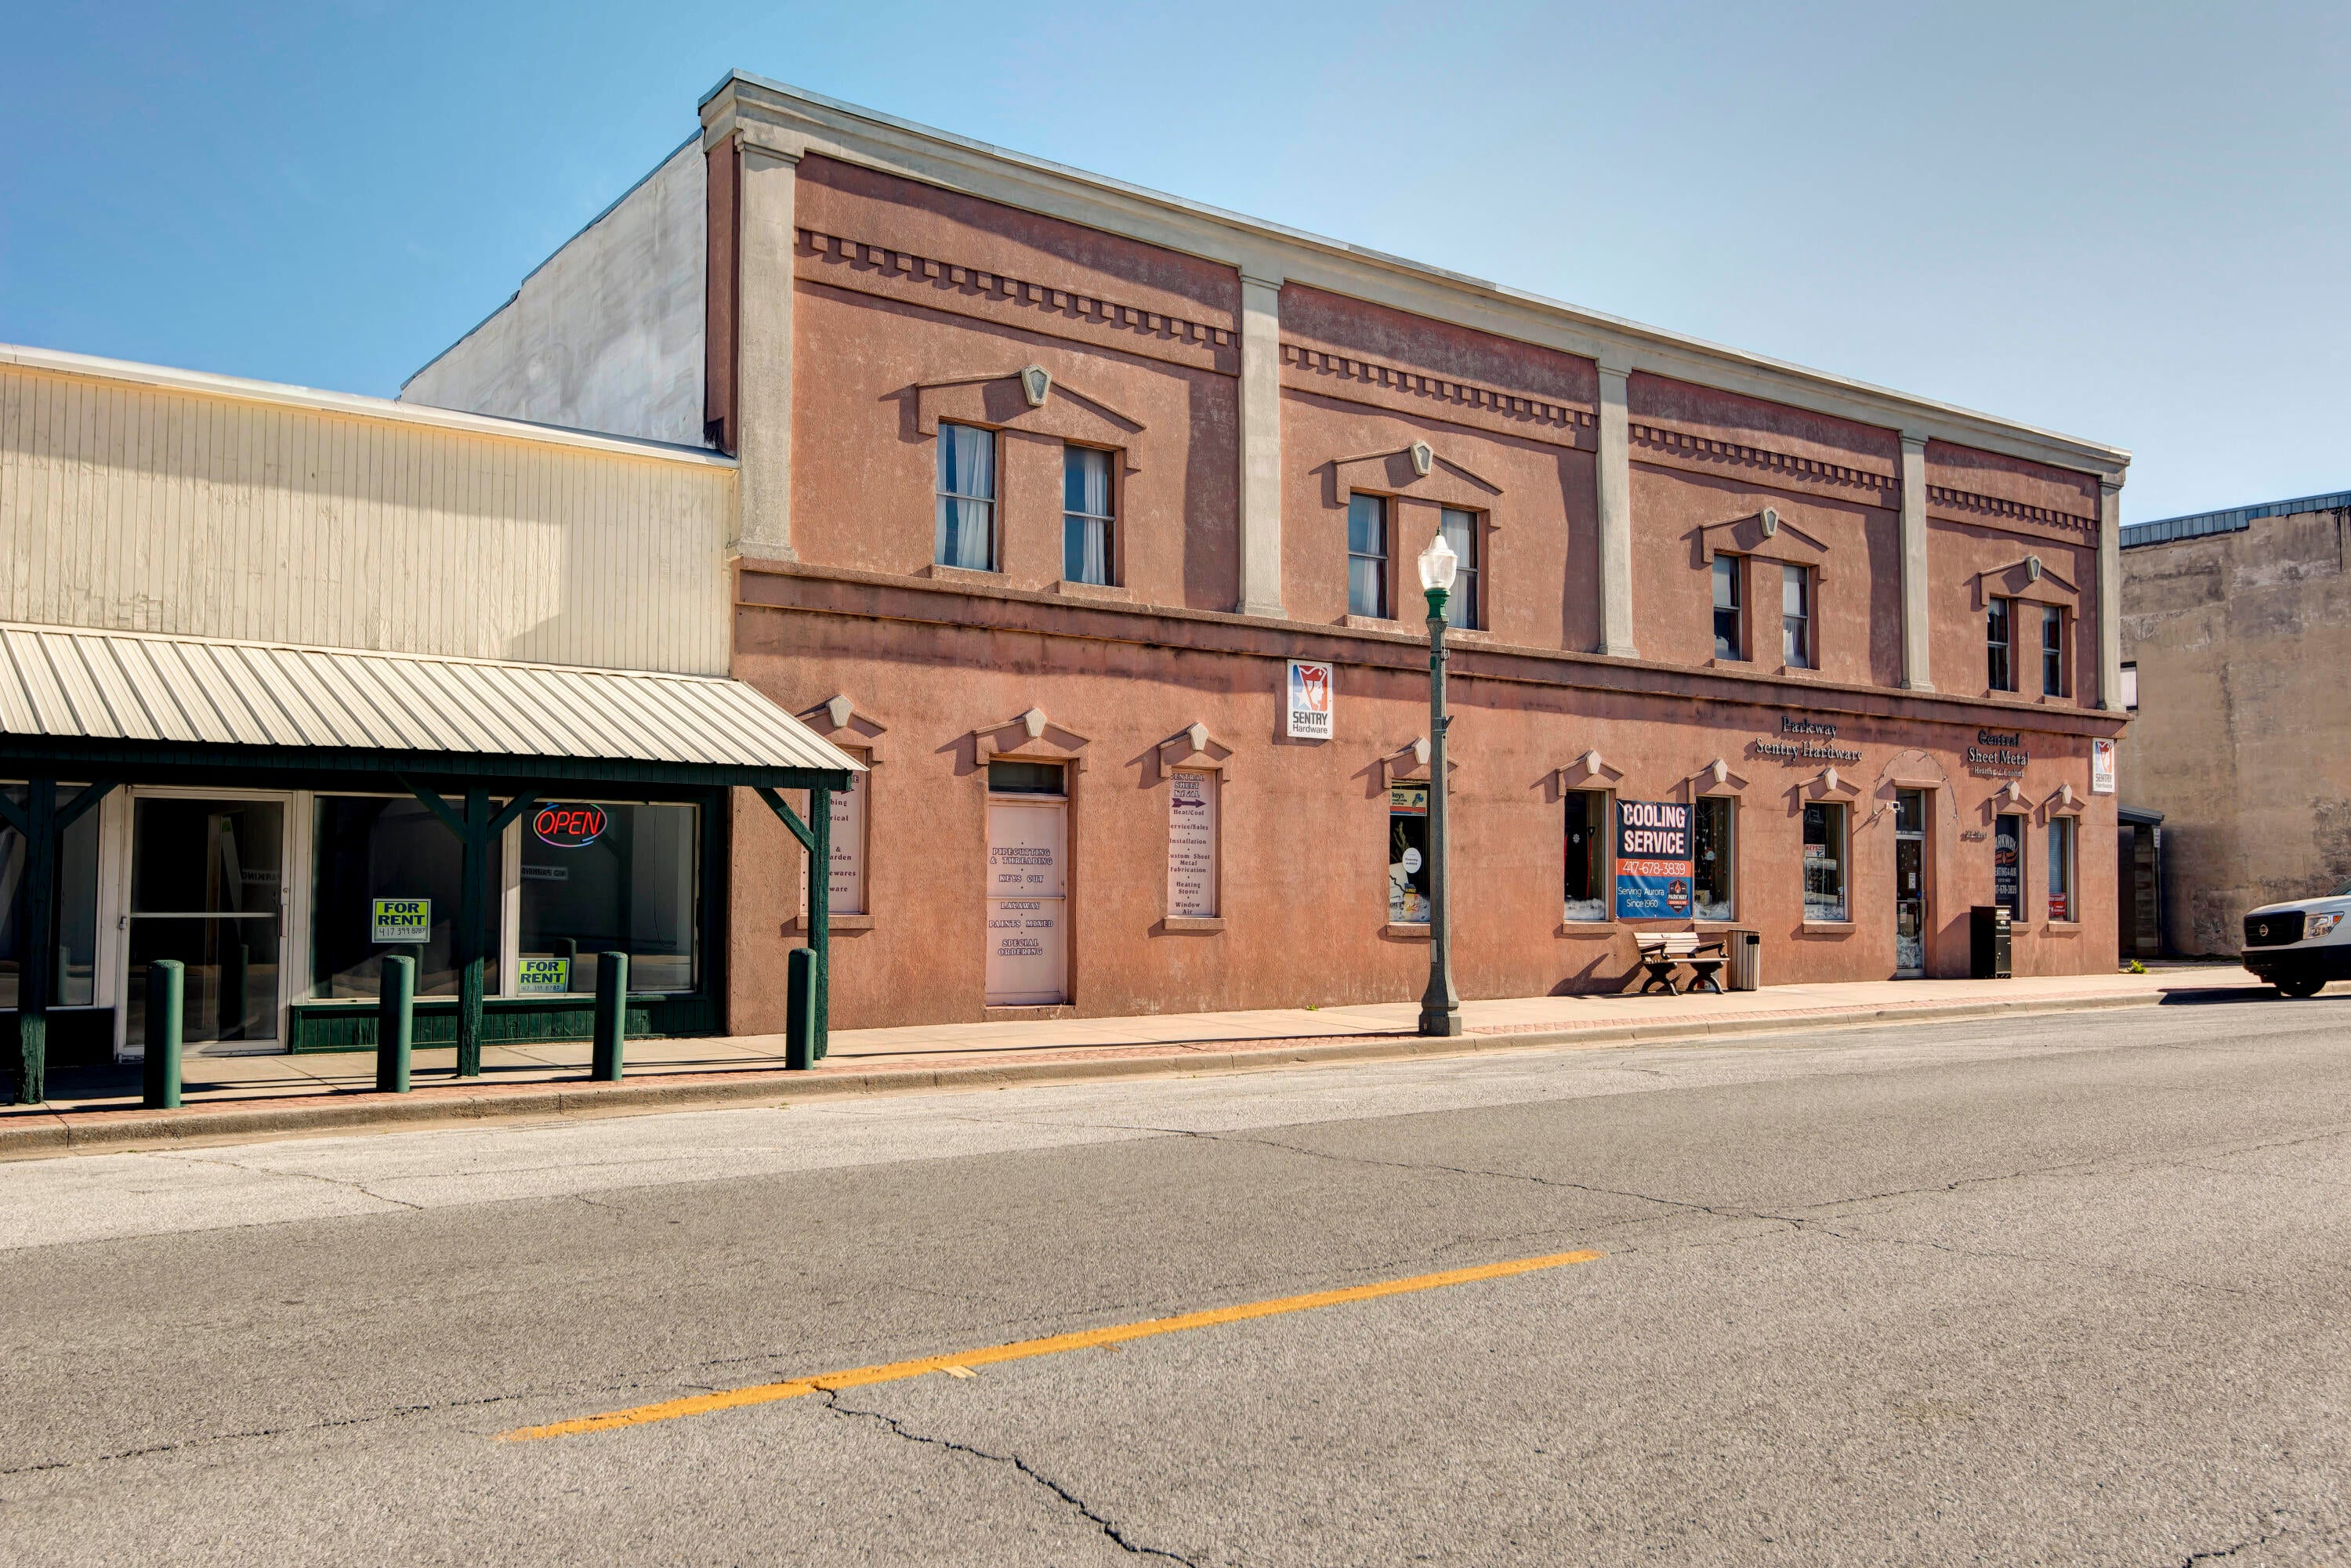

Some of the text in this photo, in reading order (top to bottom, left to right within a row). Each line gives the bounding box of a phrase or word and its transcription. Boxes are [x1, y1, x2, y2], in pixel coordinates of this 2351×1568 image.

[1292, 711, 1328, 725] SENTRY
[1292, 723, 1328, 734] Hardware
[1781, 715, 1837, 740] Parkway
[1978, 730, 2020, 747] Central
[1755, 737, 1864, 761] Sentry Hardware
[1968, 747, 2030, 766] Sheet Metal
[1974, 766, 1996, 777] Heating
[2003, 769, 2025, 778] Cooling
[2095, 773, 2113, 783] SENTRY
[1174, 781, 1200, 790] SHEET
[1623, 803, 1686, 828] COOLING
[537, 811, 601, 835] OPEN
[1624, 829, 1685, 854] SERVICE
[1994, 834, 2017, 853] ARKWAY
[992, 848, 1051, 856] PIPECUTTING
[1002, 856, 1053, 865] THREADING
[1623, 861, 1686, 875] 417-678-3839
[1994, 867, 2007, 877] EATING
[1617, 886, 1665, 897] Serving Aurora
[384, 902, 420, 914] FOR
[1626, 899, 1659, 907] Since 1960
[378, 914, 426, 925] RENT
[379, 927, 395, 936] 417
[397, 927, 411, 936] 399
[1002, 939, 1039, 947] SPECIAL
[526, 961, 560, 972] FOR
[520, 972, 564, 983] RENT
